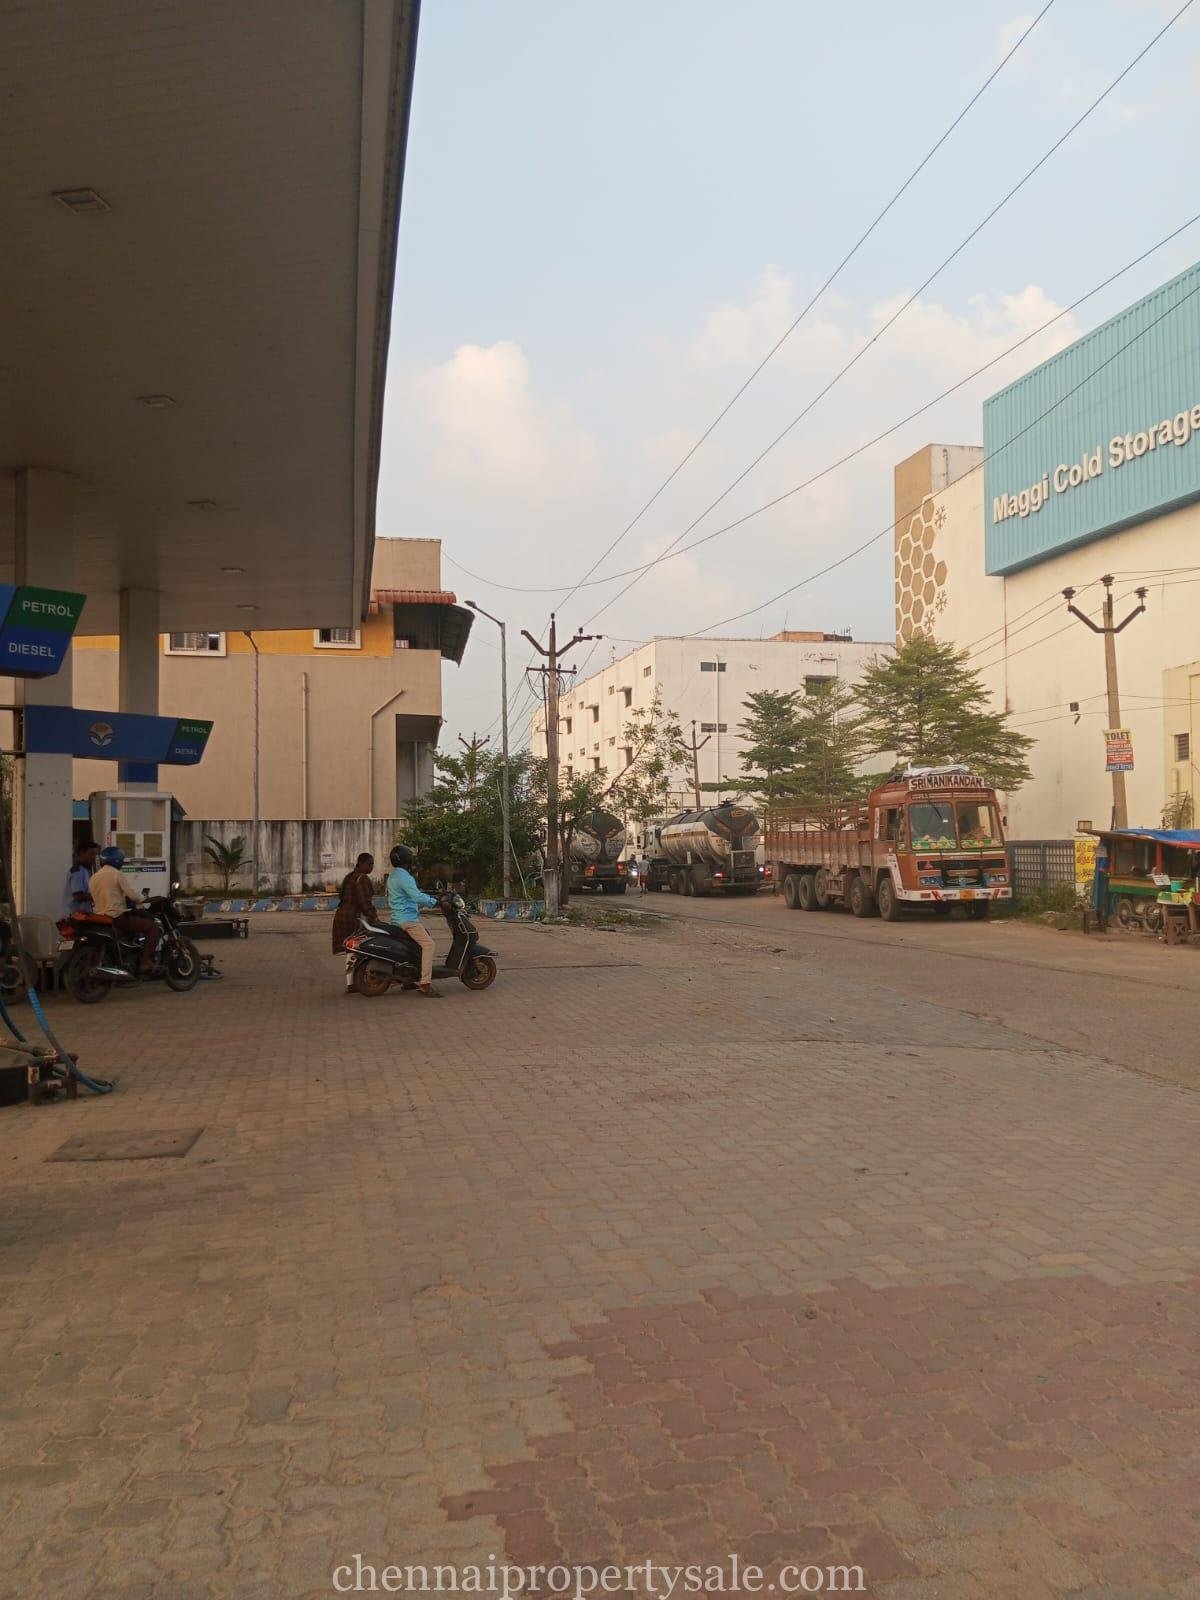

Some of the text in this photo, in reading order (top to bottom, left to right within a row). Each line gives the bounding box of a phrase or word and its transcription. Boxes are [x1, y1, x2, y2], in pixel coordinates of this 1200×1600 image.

[993, 403, 1200, 523] Maggi Cold Storage
[22, 600, 74, 617] PETROL
[8, 642, 56, 658] DIESEL
